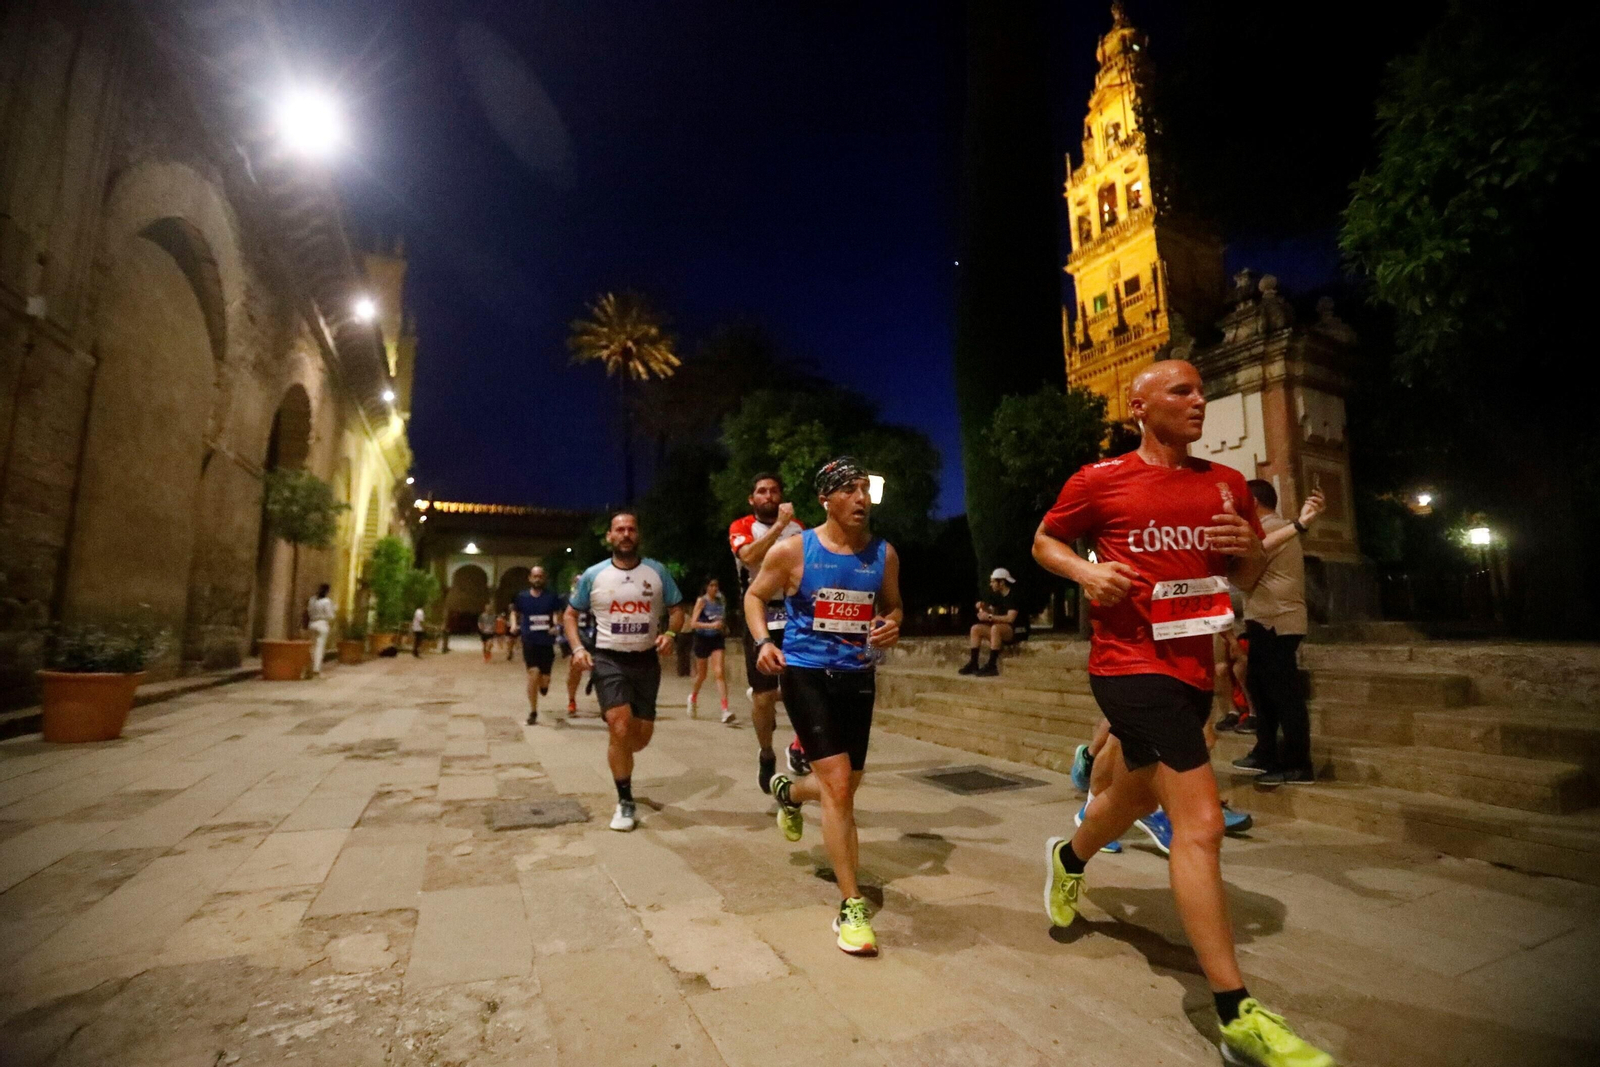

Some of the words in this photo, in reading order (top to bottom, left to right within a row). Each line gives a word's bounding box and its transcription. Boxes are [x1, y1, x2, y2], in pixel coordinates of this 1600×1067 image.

[1127, 519, 1213, 552] CÓRDO
[1173, 583, 1188, 595] 20
[834, 592, 845, 601] 20
[609, 600, 651, 614] AON
[828, 603, 860, 617] 1465
[1169, 595, 1213, 615] 1933
[620, 623, 642, 633] 1189
